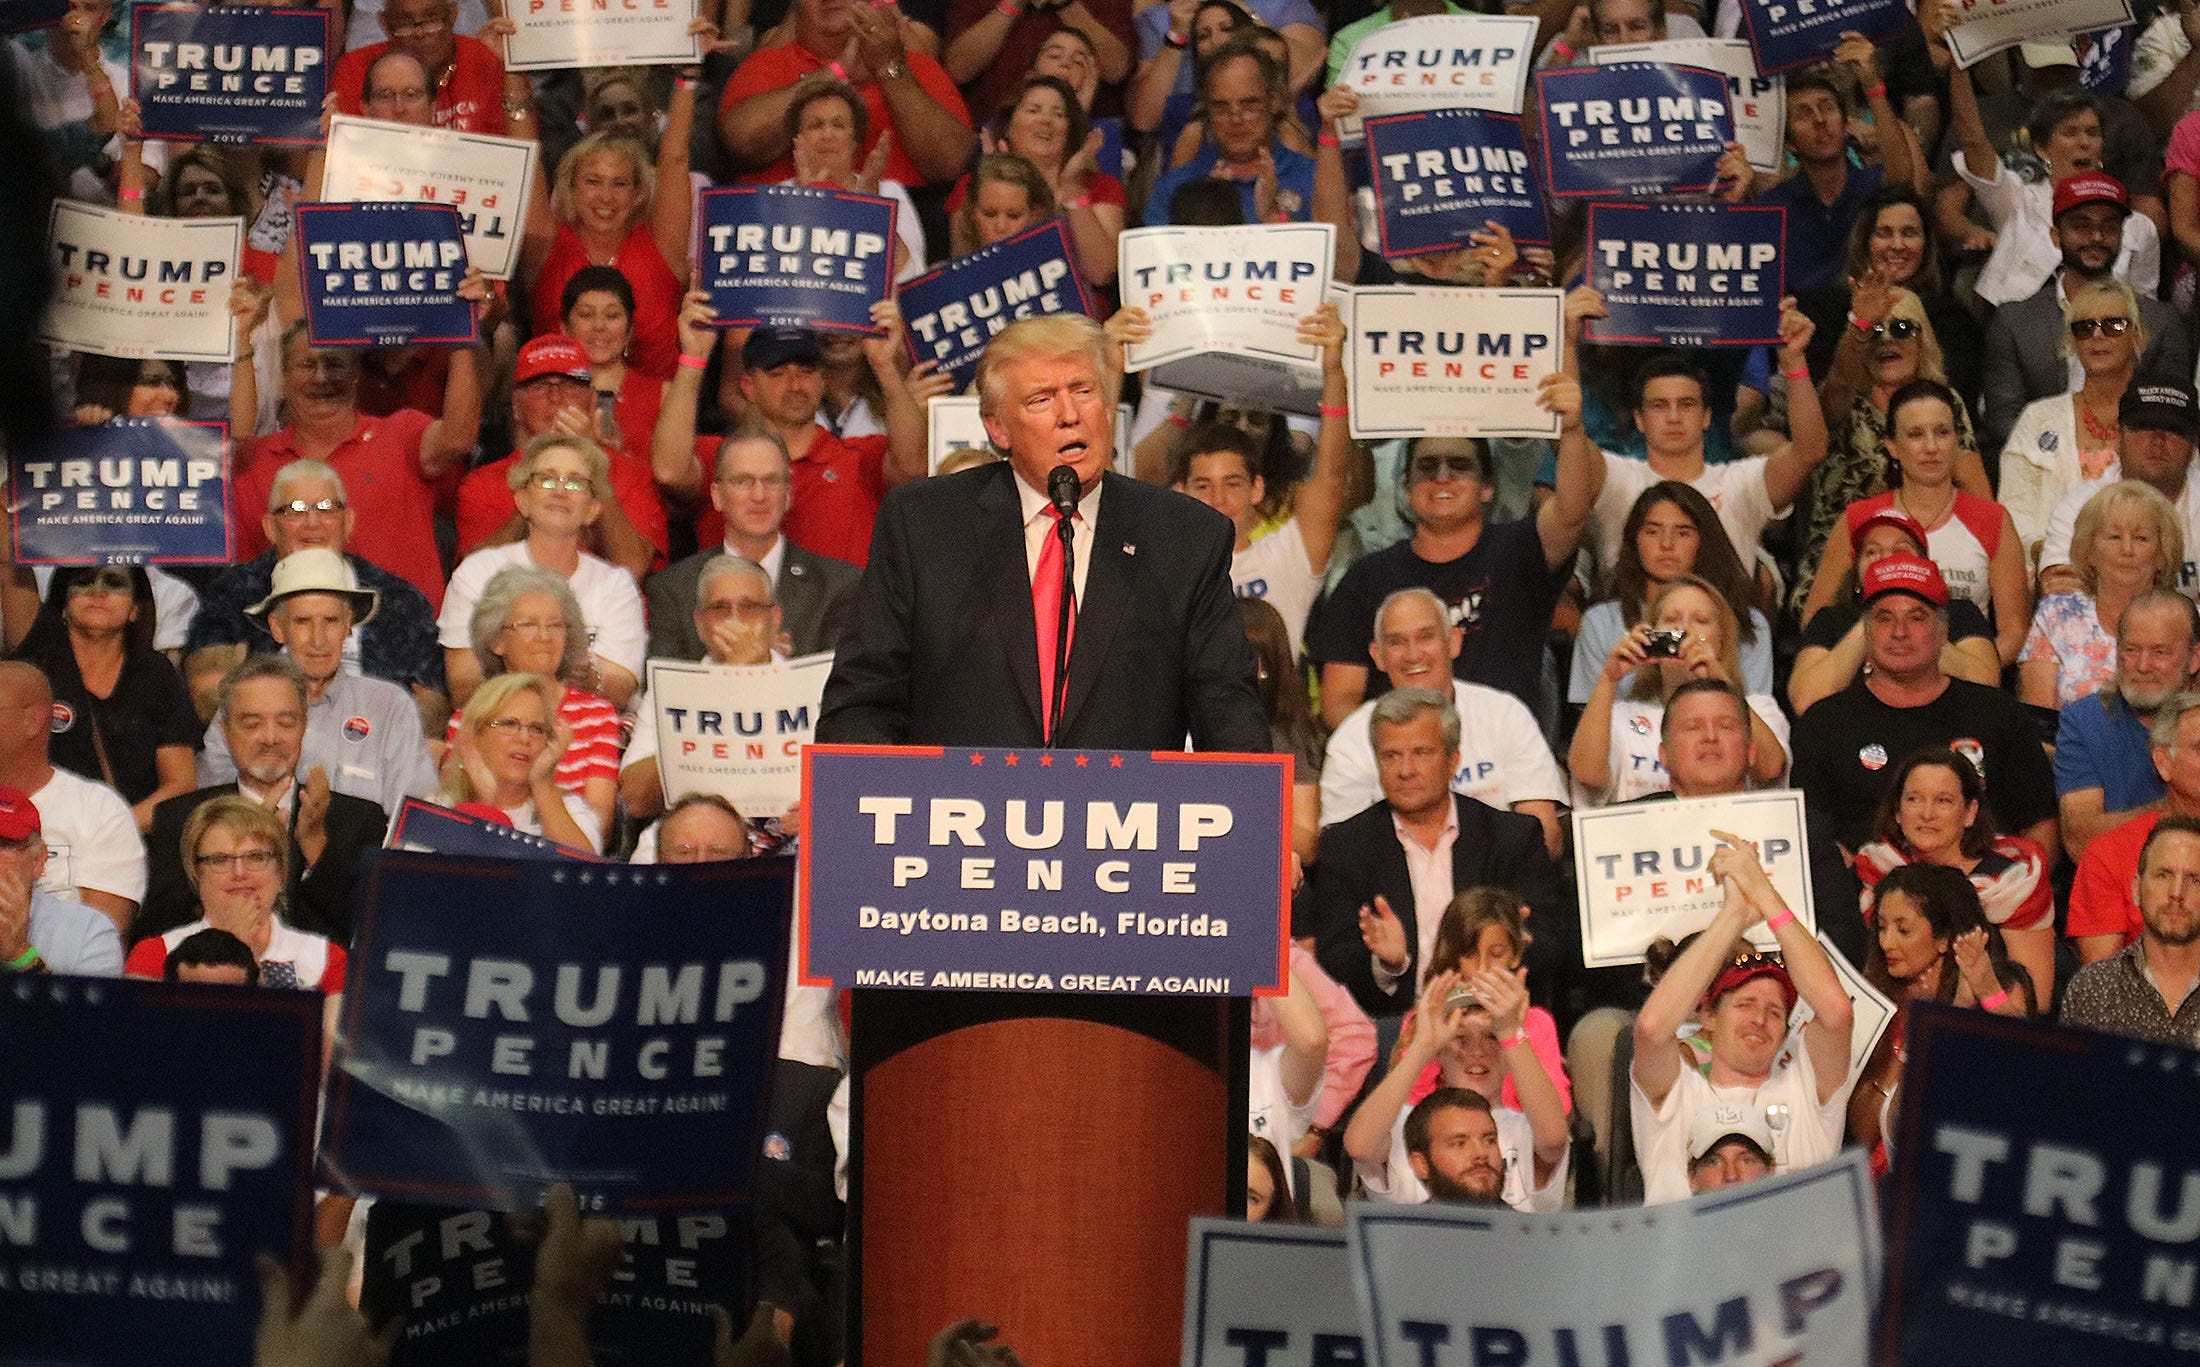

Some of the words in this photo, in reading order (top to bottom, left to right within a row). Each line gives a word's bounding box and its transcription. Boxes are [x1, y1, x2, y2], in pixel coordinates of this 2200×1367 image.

[605, 16, 636, 25] GREAT
[640, 15, 674, 24] AGAIN!
[144, 42, 320, 72] TRUMP
[1361, 48, 1514, 69] TRUMP
[158, 74, 305, 93] PENCE
[1363, 72, 1494, 86] PENCE
[152, 95, 181, 104] MAKE
[183, 96, 230, 105] AMERICA
[234, 97, 268, 106] GREAT
[269, 98, 307, 108] AGAIN!
[1551, 97, 1725, 127] TRUMP
[213, 134, 244, 144] 2016
[1568, 122, 1716, 147] PENCE
[1382, 146, 1528, 182] TRUMP
[1597, 147, 1646, 159] AMERICA
[430, 170, 472, 184] AMERICA
[475, 174, 504, 187] MAKE
[1402, 174, 1527, 202] PENCE
[356, 176, 497, 209] PENCE
[1432, 200, 1479, 213] AMERICA
[709, 224, 886, 259] TRUMP
[57, 242, 225, 284] TRUMP
[309, 241, 459, 270] TRUMP
[720, 254, 867, 280] PENCE
[1598, 239, 1776, 271] TRUMP
[325, 272, 452, 292] PENCE
[714, 279, 740, 288] MAKE
[742, 278, 788, 288] AMERICA
[791, 280, 825, 290] GREAT
[829, 282, 867, 295] AGAIN!
[1135, 261, 1315, 288] TRUMP
[1614, 270, 1759, 292] PENCE
[68, 274, 206, 304] PENCE
[322, 298, 348, 307] MAKE
[350, 297, 391, 307] AMERICA
[393, 296, 420, 306] GREAT
[422, 296, 453, 306] AGAIN!
[911, 258, 1067, 342] TRUMP
[1150, 287, 1295, 308] PENCE
[1640, 295, 1688, 307] AMERICA
[1691, 296, 1725, 307] GREAT
[136, 308, 169, 319] GREAT
[173, 310, 208, 320] AGAIN!
[770, 316, 801, 326] 2016
[934, 292, 1062, 359] PENCE
[1365, 331, 1548, 357] TRUMP
[1671, 335, 1703, 346] 2016
[1380, 362, 1529, 379] PENCE
[25, 459, 218, 488] TRUMP
[42, 492, 198, 510] PENCE
[37, 516, 68, 525] MAKE
[71, 514, 121, 525] AMERICA
[125, 515, 160, 525] GREAT
[164, 515, 204, 526] AGAIN!
[107, 555, 141, 565] 2016
[665, 706, 810, 737] TRUM
[682, 740, 799, 759] PENC
[679, 764, 703, 772] MAKE
[707, 766, 756, 775] AMERICA
[760, 765, 796, 773] GREAT
[858, 796, 1234, 851] TRUMP
[1596, 838, 1791, 880] TRUP
[893, 856, 1197, 893] PENCE
[1648, 902, 1696, 914] AMERICA
[1702, 901, 1724, 910] GRE
[859, 905, 988, 935] Daytona
[1000, 910, 1106, 938] Beach,
[1116, 912, 1229, 938] Florida
[386, 951, 767, 1026] TRUMP
[856, 969, 925, 987] MAKE
[931, 972, 1054, 990] AMERICA
[1060, 974, 1141, 992] GREAT
[1146, 976, 1230, 994] AGAIN!
[410, 1028, 727, 1080] PENCE
[392, 1081, 464, 1106] MAKE
[473, 1089, 585, 1115] AMERICA
[592, 1098, 660, 1117] GREAT
[664, 1095, 727, 1114] AGAIN!
[536, 1193, 606, 1212] 216
[20, 1268, 121, 1294] GREAT
[133, 1273, 235, 1300] AGAIN!
[406, 1311, 461, 1340] MAKE
[1400, 1269, 1845, 1367] TRUMP
